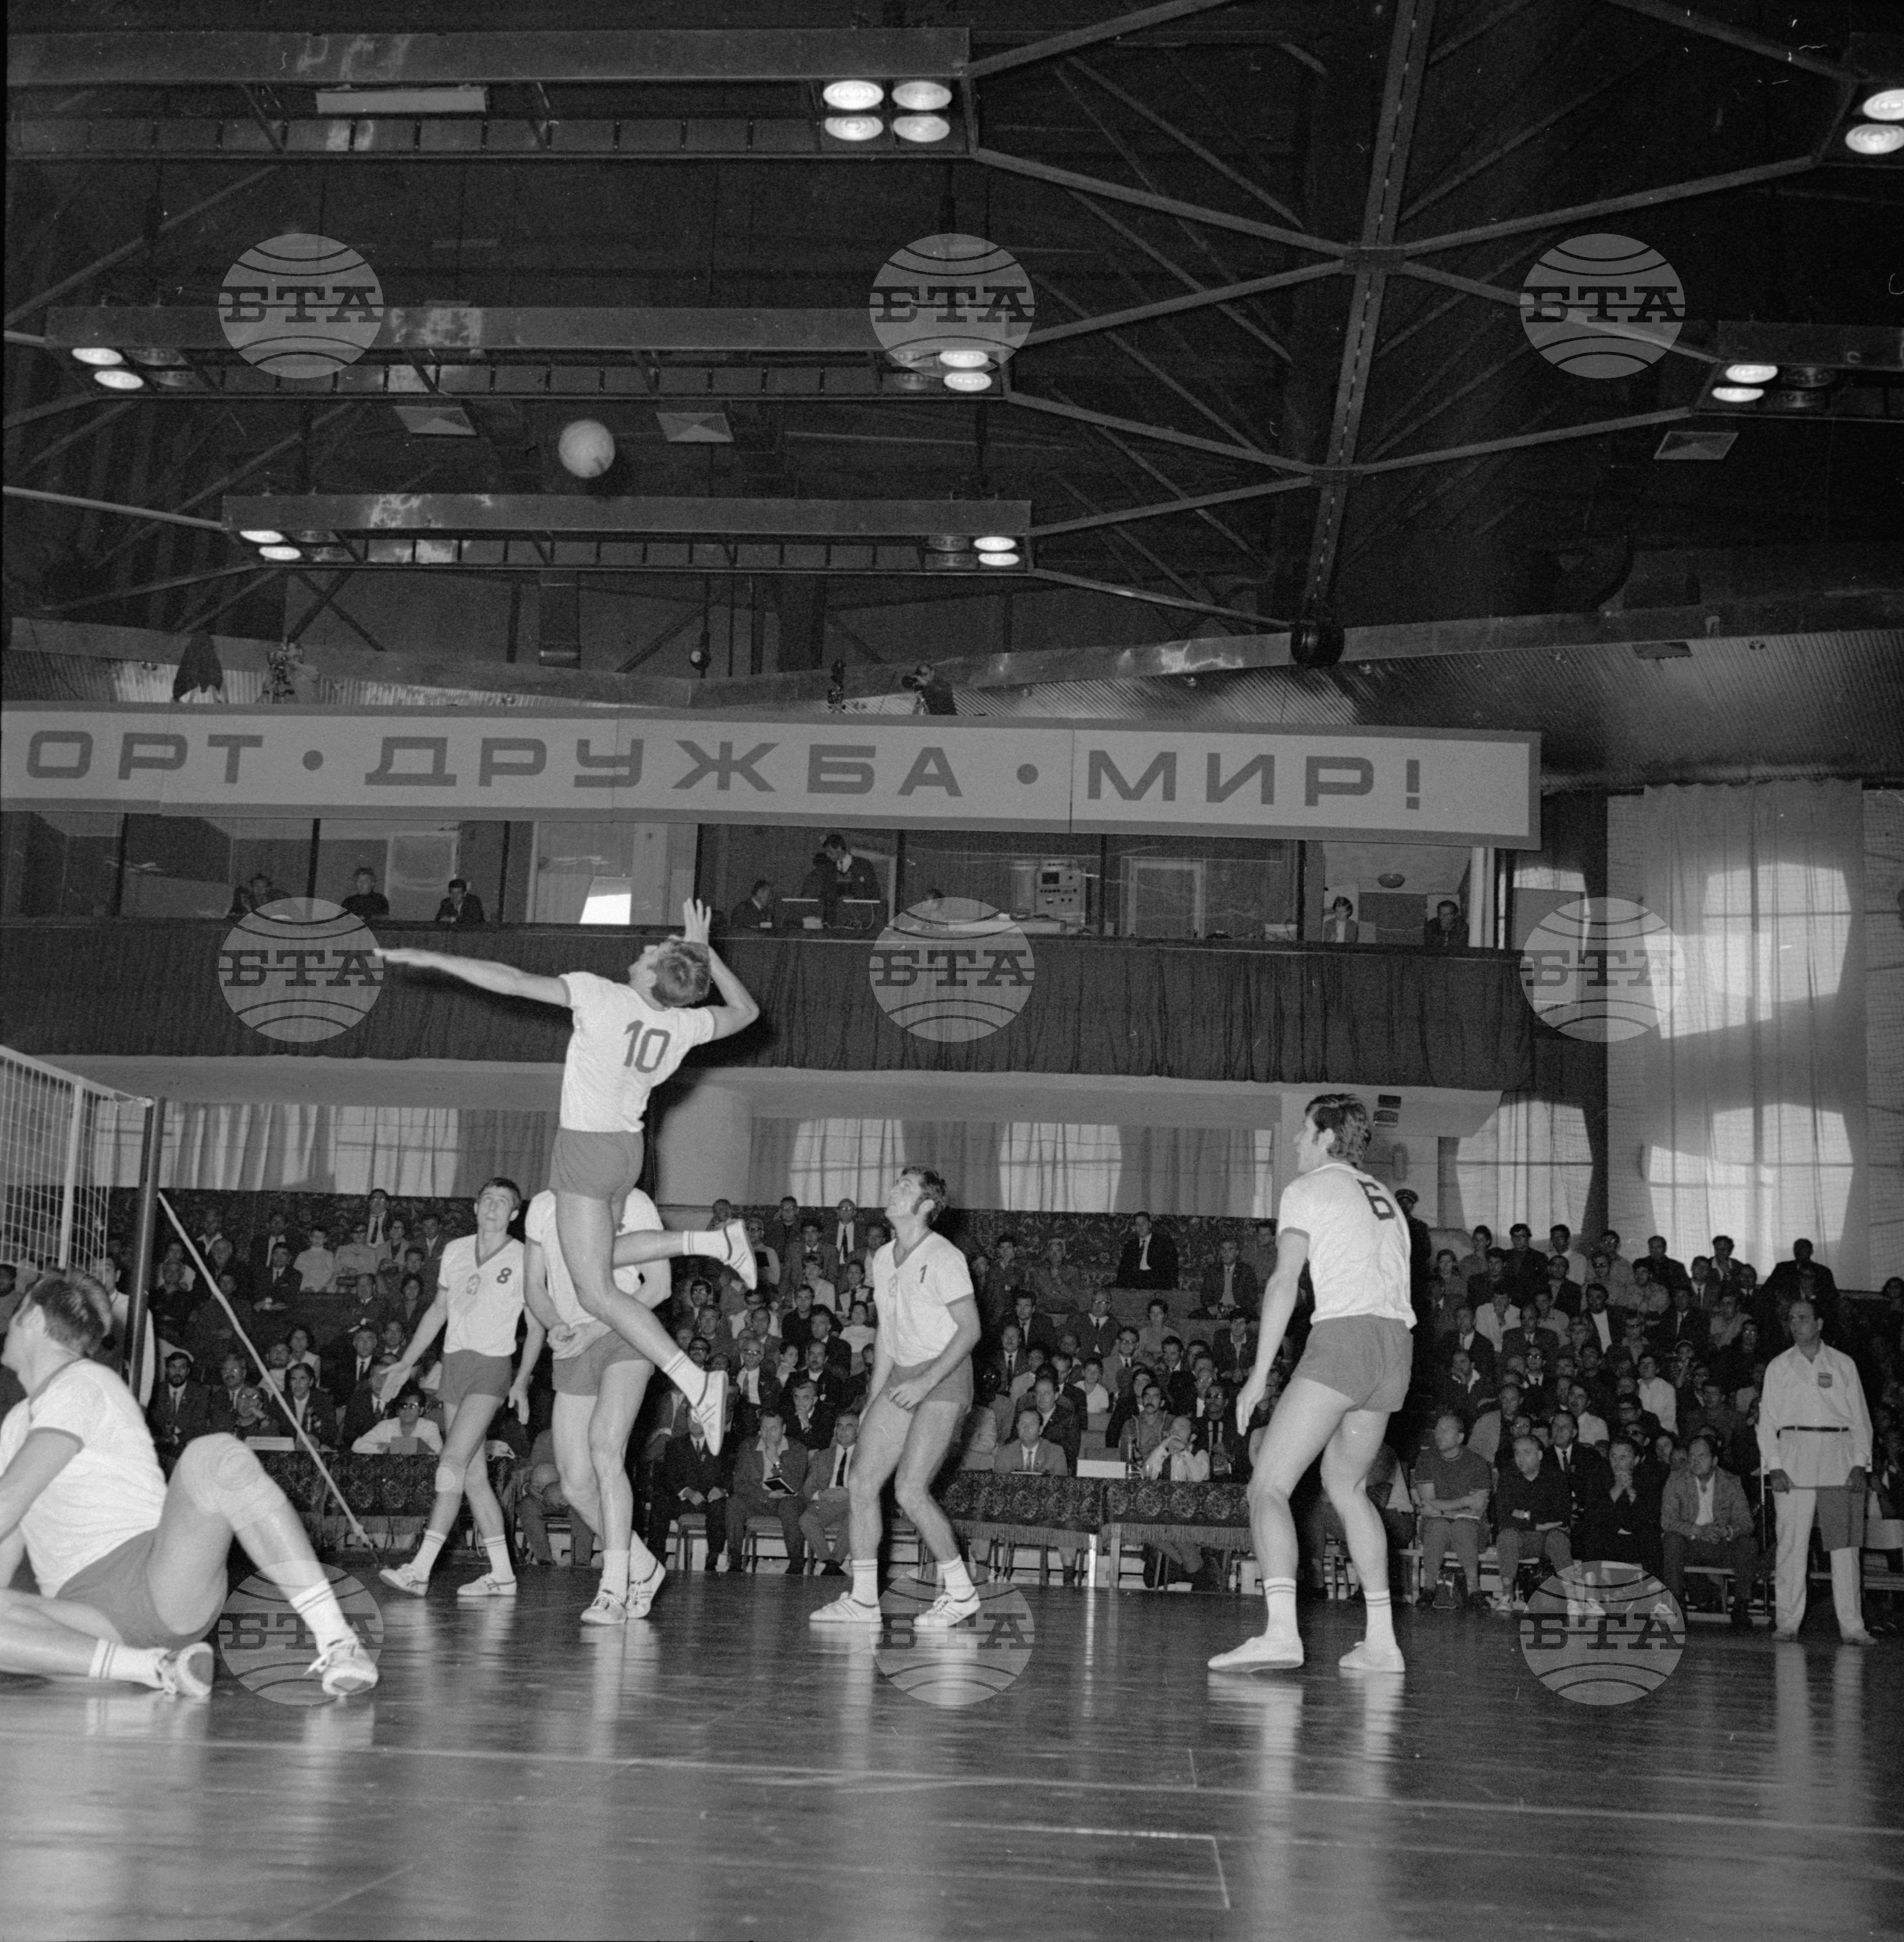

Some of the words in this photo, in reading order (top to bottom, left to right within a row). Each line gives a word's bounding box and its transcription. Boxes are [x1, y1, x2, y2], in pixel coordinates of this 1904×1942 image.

[364, 736, 963, 798] ДРУЖБА
[1086, 749, 1420, 810] МИР!
[623, 1020, 671, 1073] 10
[1357, 1179, 1396, 1221] 6
[496, 1267, 513, 1284] 8
[919, 1265, 927, 1284] 1
